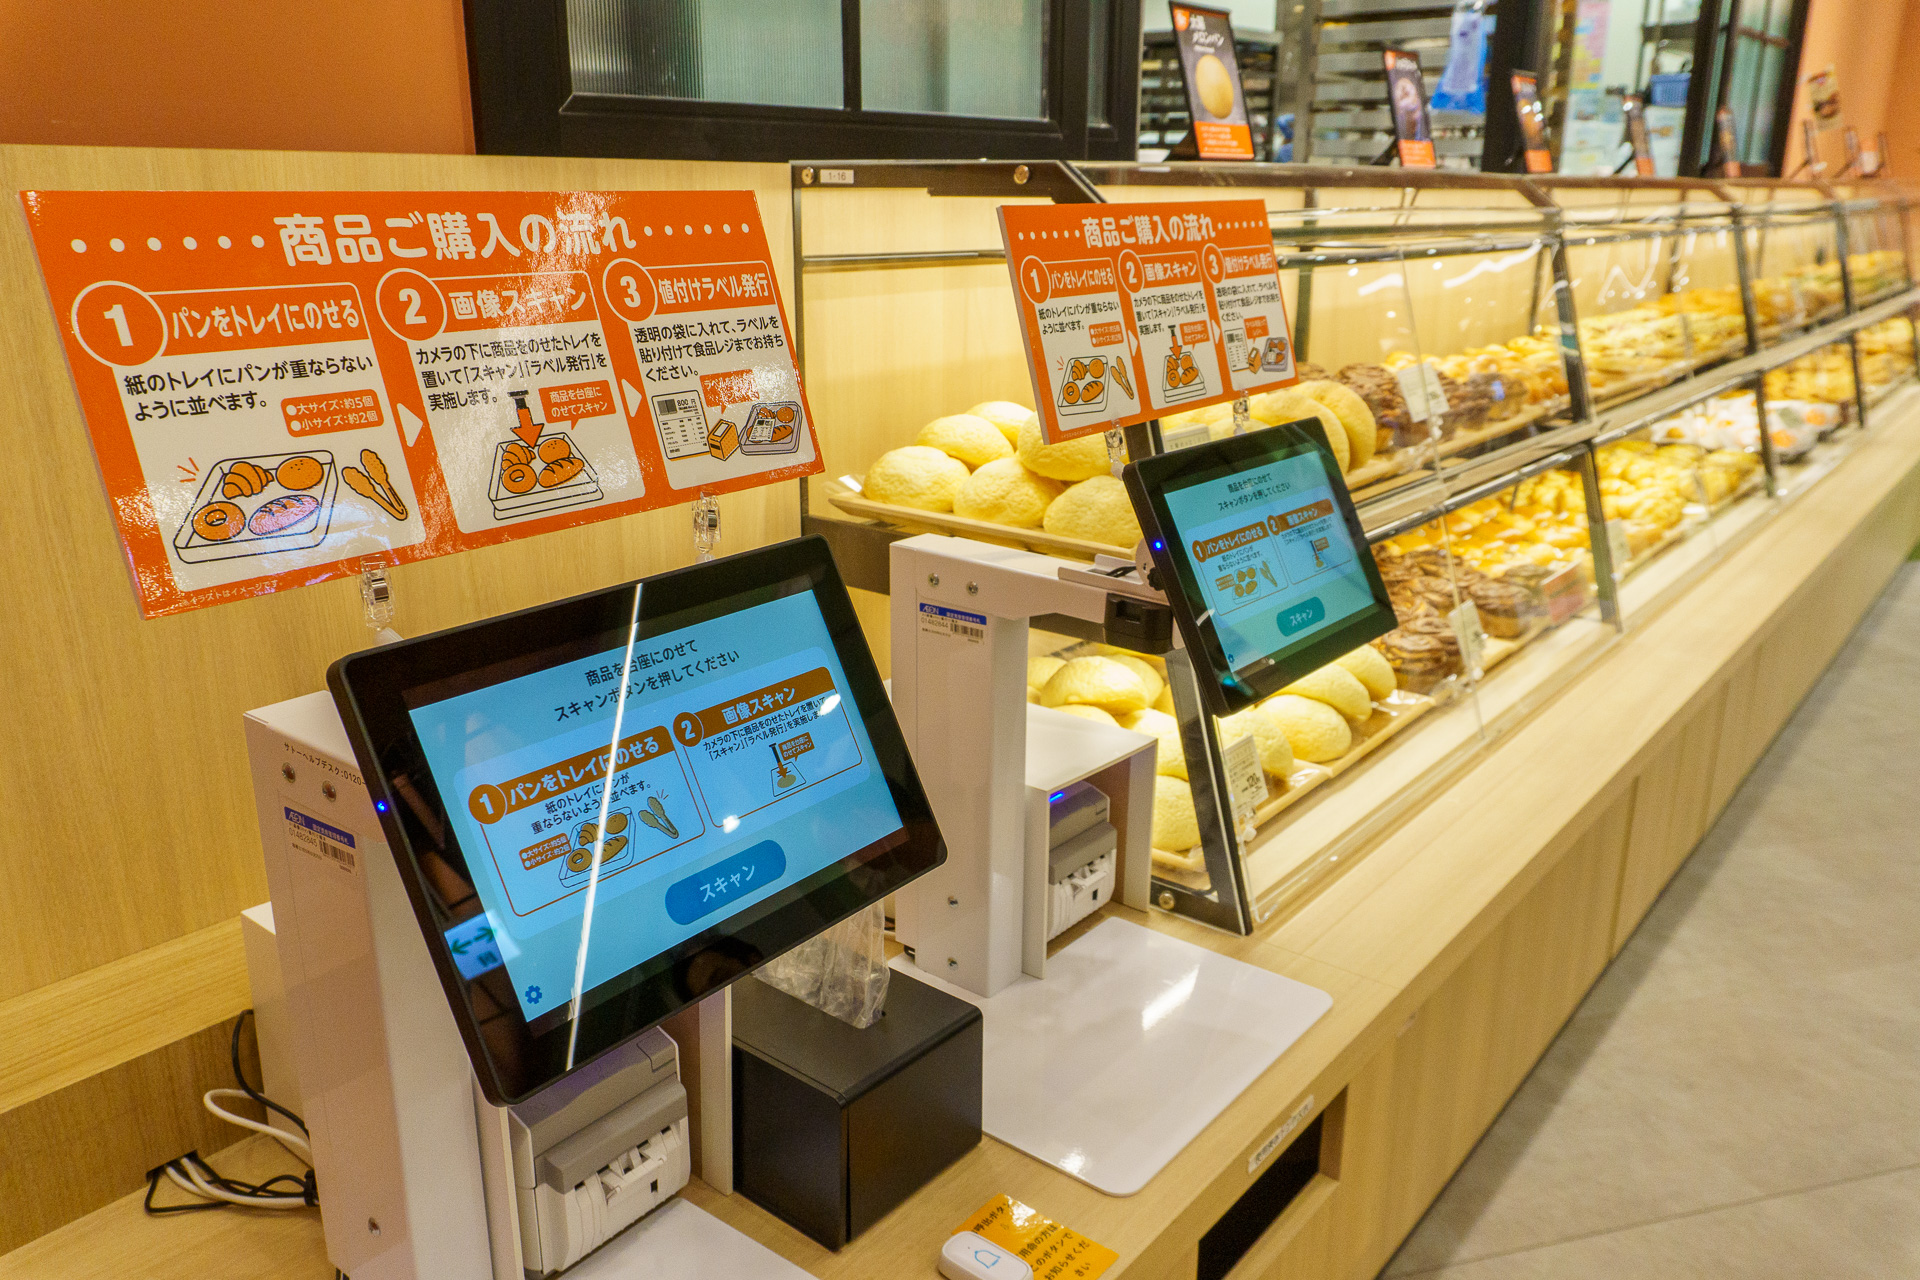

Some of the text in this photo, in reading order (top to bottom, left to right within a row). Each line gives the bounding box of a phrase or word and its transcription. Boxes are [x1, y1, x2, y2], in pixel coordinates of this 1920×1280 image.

[273, 210, 637, 267] 商品ご購入の流れ
[1081, 212, 1217, 249] 商品ご購入の流れ
[1029, 267, 1042, 294] 1
[1051, 267, 1114, 291] パンをトレイにのせる
[1126, 260, 1138, 284] 2
[1144, 261, 1198, 282] 画像スキャン
[1209, 255, 1219, 276] 3
[447, 283, 588, 322] 画像スキャン
[619, 274, 643, 309] 3
[658, 271, 771, 305] 値付けラベル発行
[172, 299, 360, 340] パンをトレイにのせる
[398, 288, 427, 325] 2
[1038, 301, 1120, 321] 紙のトレイにパンが重ならない
[103, 303, 134, 347] 1
[634, 314, 780, 345] 透明の袋に入れて、ラベルを
[1042, 320, 1085, 335] ように並べます。
[416, 331, 602, 367] カメラの下に商品をのせたトレイを
[639, 333, 785, 365] 貼り付けて食品レジまでお持ち
[124, 354, 373, 396] 紙のトレイにパンが重ならない
[421, 351, 608, 389] 置いて「スキャン」「ラベル発行」を
[645, 365, 700, 383] ください。
[134, 390, 267, 422] ように並べます。
[428, 387, 499, 412] 実施します。
[548, 385, 602, 402] 商品を台座に
[551, 400, 608, 417] のせてスキャン
[1207, 526, 1264, 555] パンをトレイにのせる
[1289, 608, 1313, 627] スキャン
[584, 639, 698, 687] 商品を台座にのせて
[554, 650, 740, 722] スキャンボタンを押してください
[721, 687, 796, 725] 画像スキャン
[681, 719, 696, 740] 2
[510, 736, 660, 806] パンをトレイにのせる
[479, 793, 495, 816] 1
[531, 780, 651, 835] 重ならないよう並べます。
[545, 772, 630, 814] 紙のトレイにンが
[699, 863, 756, 903] スキャン
[1074, 1261, 1092, 1278] さい
